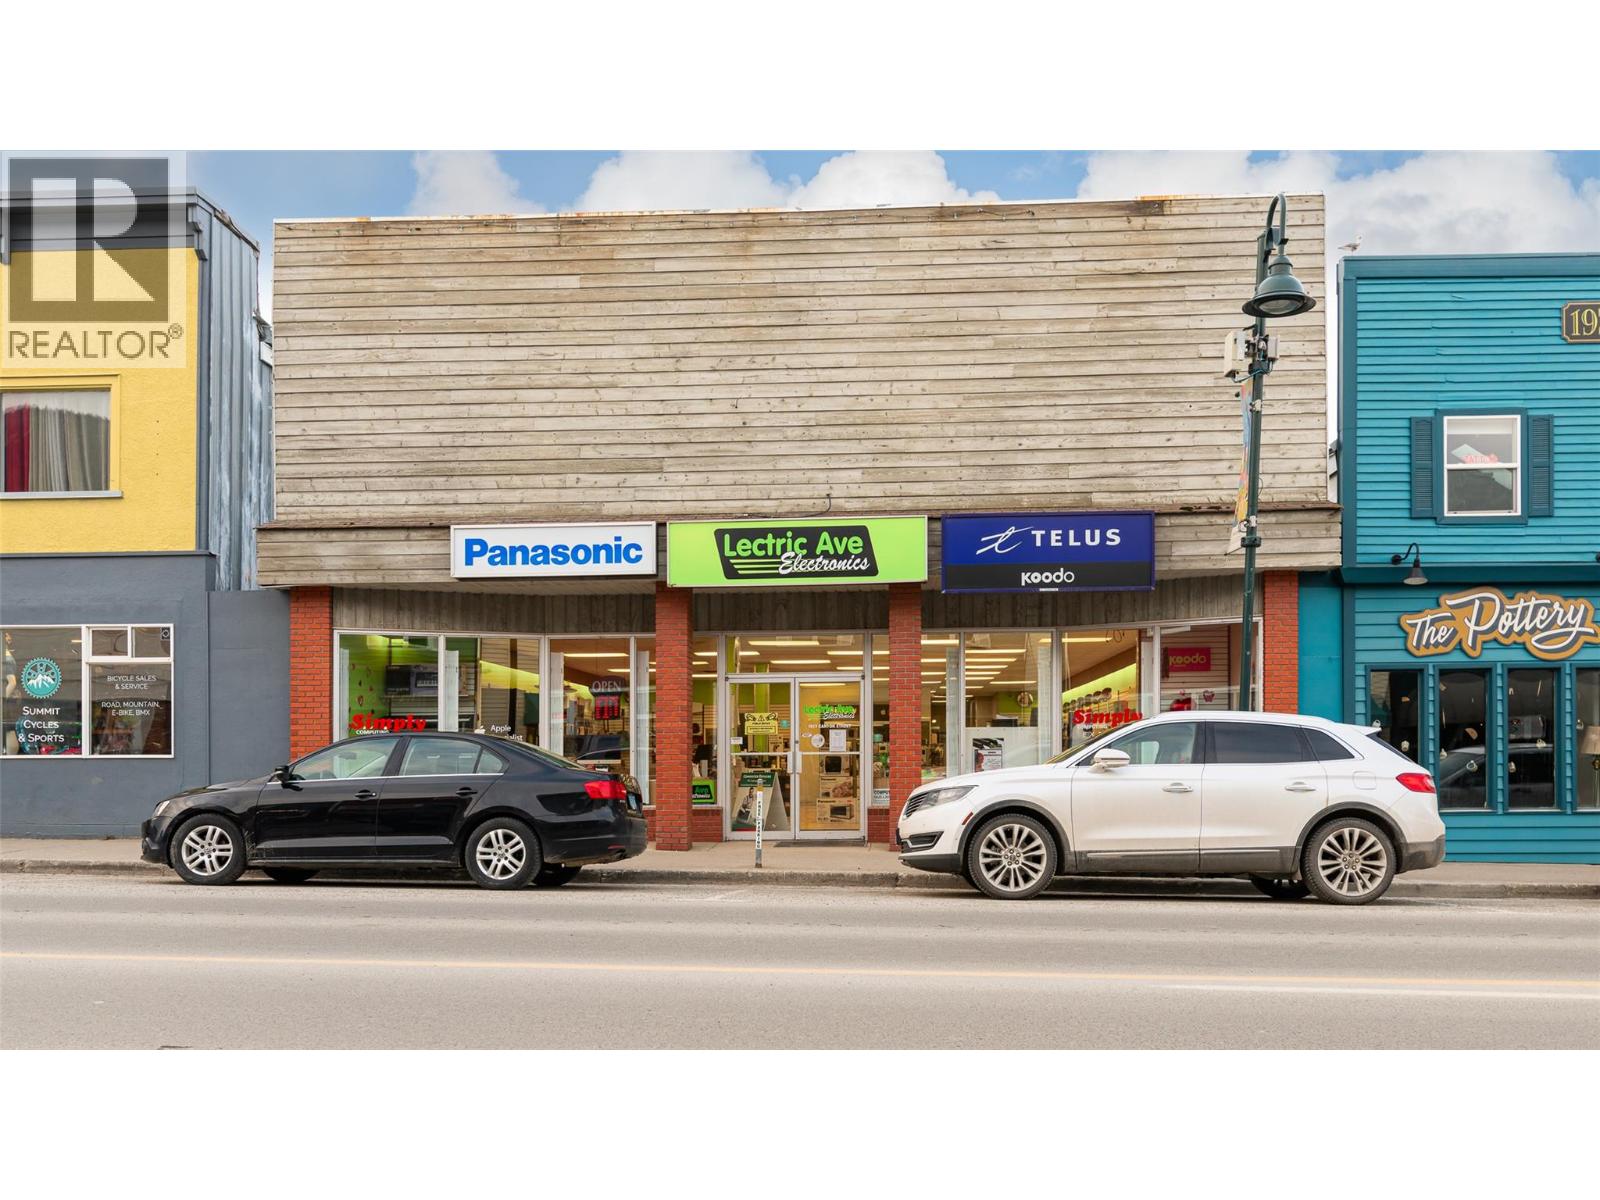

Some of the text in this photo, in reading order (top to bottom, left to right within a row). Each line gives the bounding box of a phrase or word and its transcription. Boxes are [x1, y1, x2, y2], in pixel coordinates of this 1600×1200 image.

[1570, 308, 1600, 336] 19
[724, 530, 864, 557] Lectric Ave
[1031, 528, 1121, 547] TELUS
[464, 536, 643, 566] Panasonic
[778, 551, 870, 575] Electronics
[1406, 592, 1595, 650] The Pottery
[592, 680, 621, 692] OPEN
[350, 712, 427, 733] Simply
[490, 724, 512, 734] Apple
[18, 734, 26, 743] &
